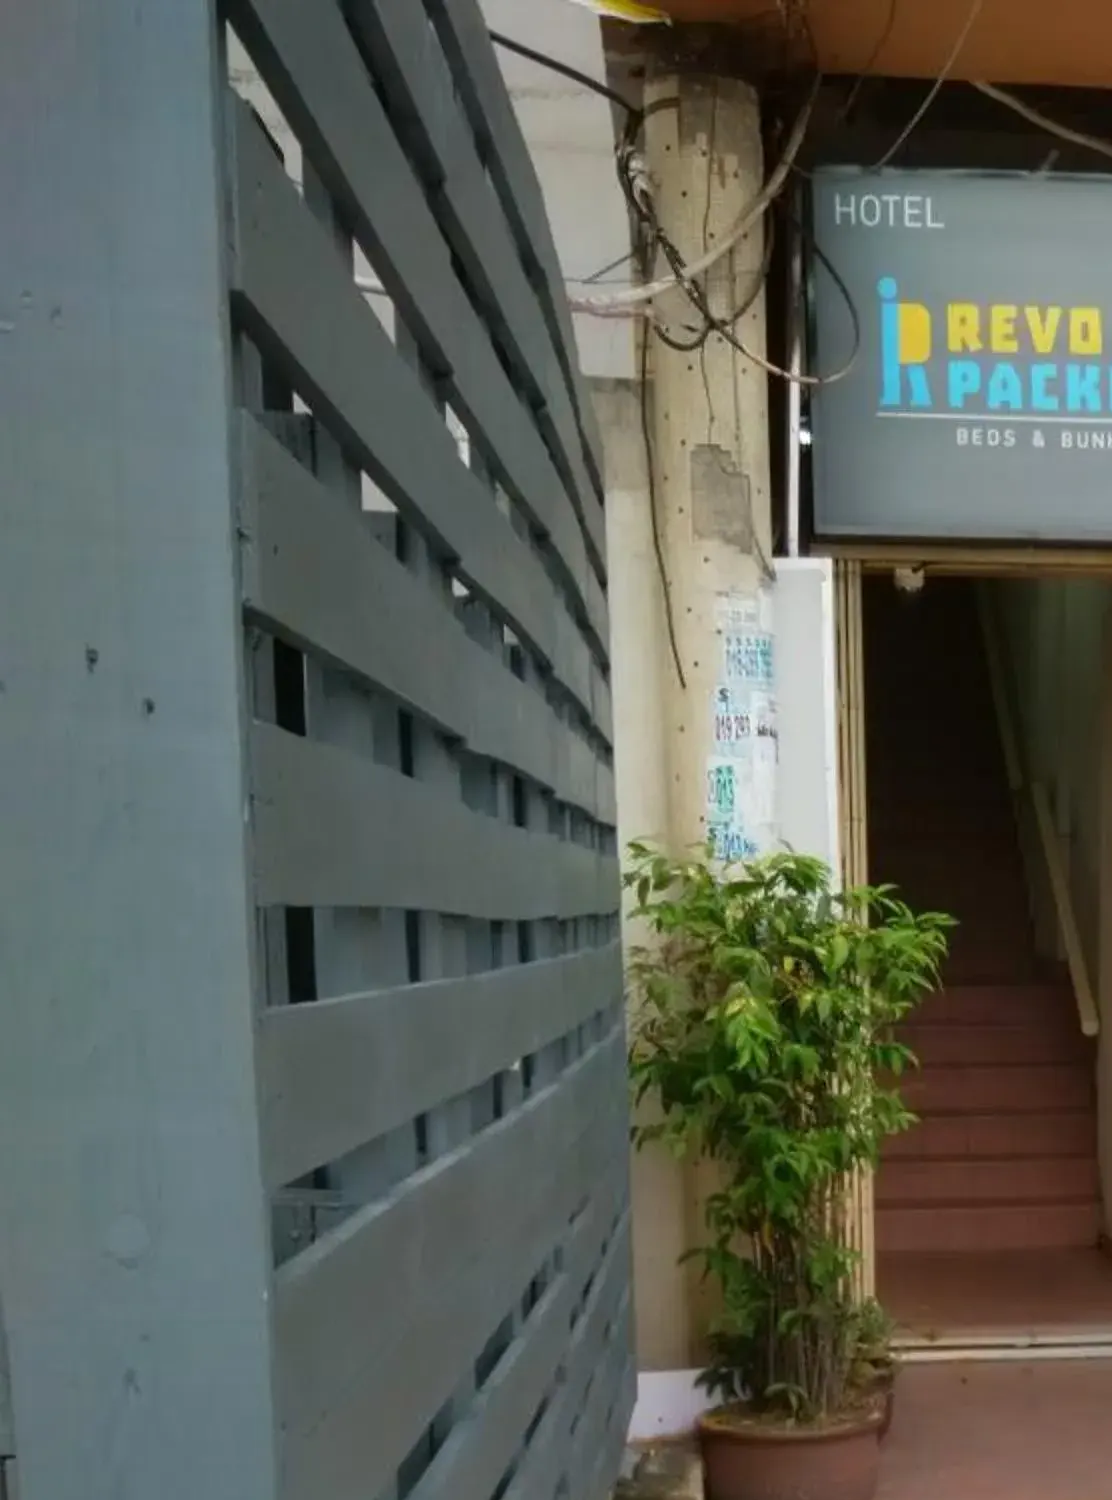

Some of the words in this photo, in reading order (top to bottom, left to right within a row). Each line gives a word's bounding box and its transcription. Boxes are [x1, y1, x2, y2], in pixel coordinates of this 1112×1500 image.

[834, 194, 945, 229] HOTEL
[947, 303, 1103, 356] REVO
[956, 428, 1016, 447] BEDS
[1032, 430, 1046, 449] &
